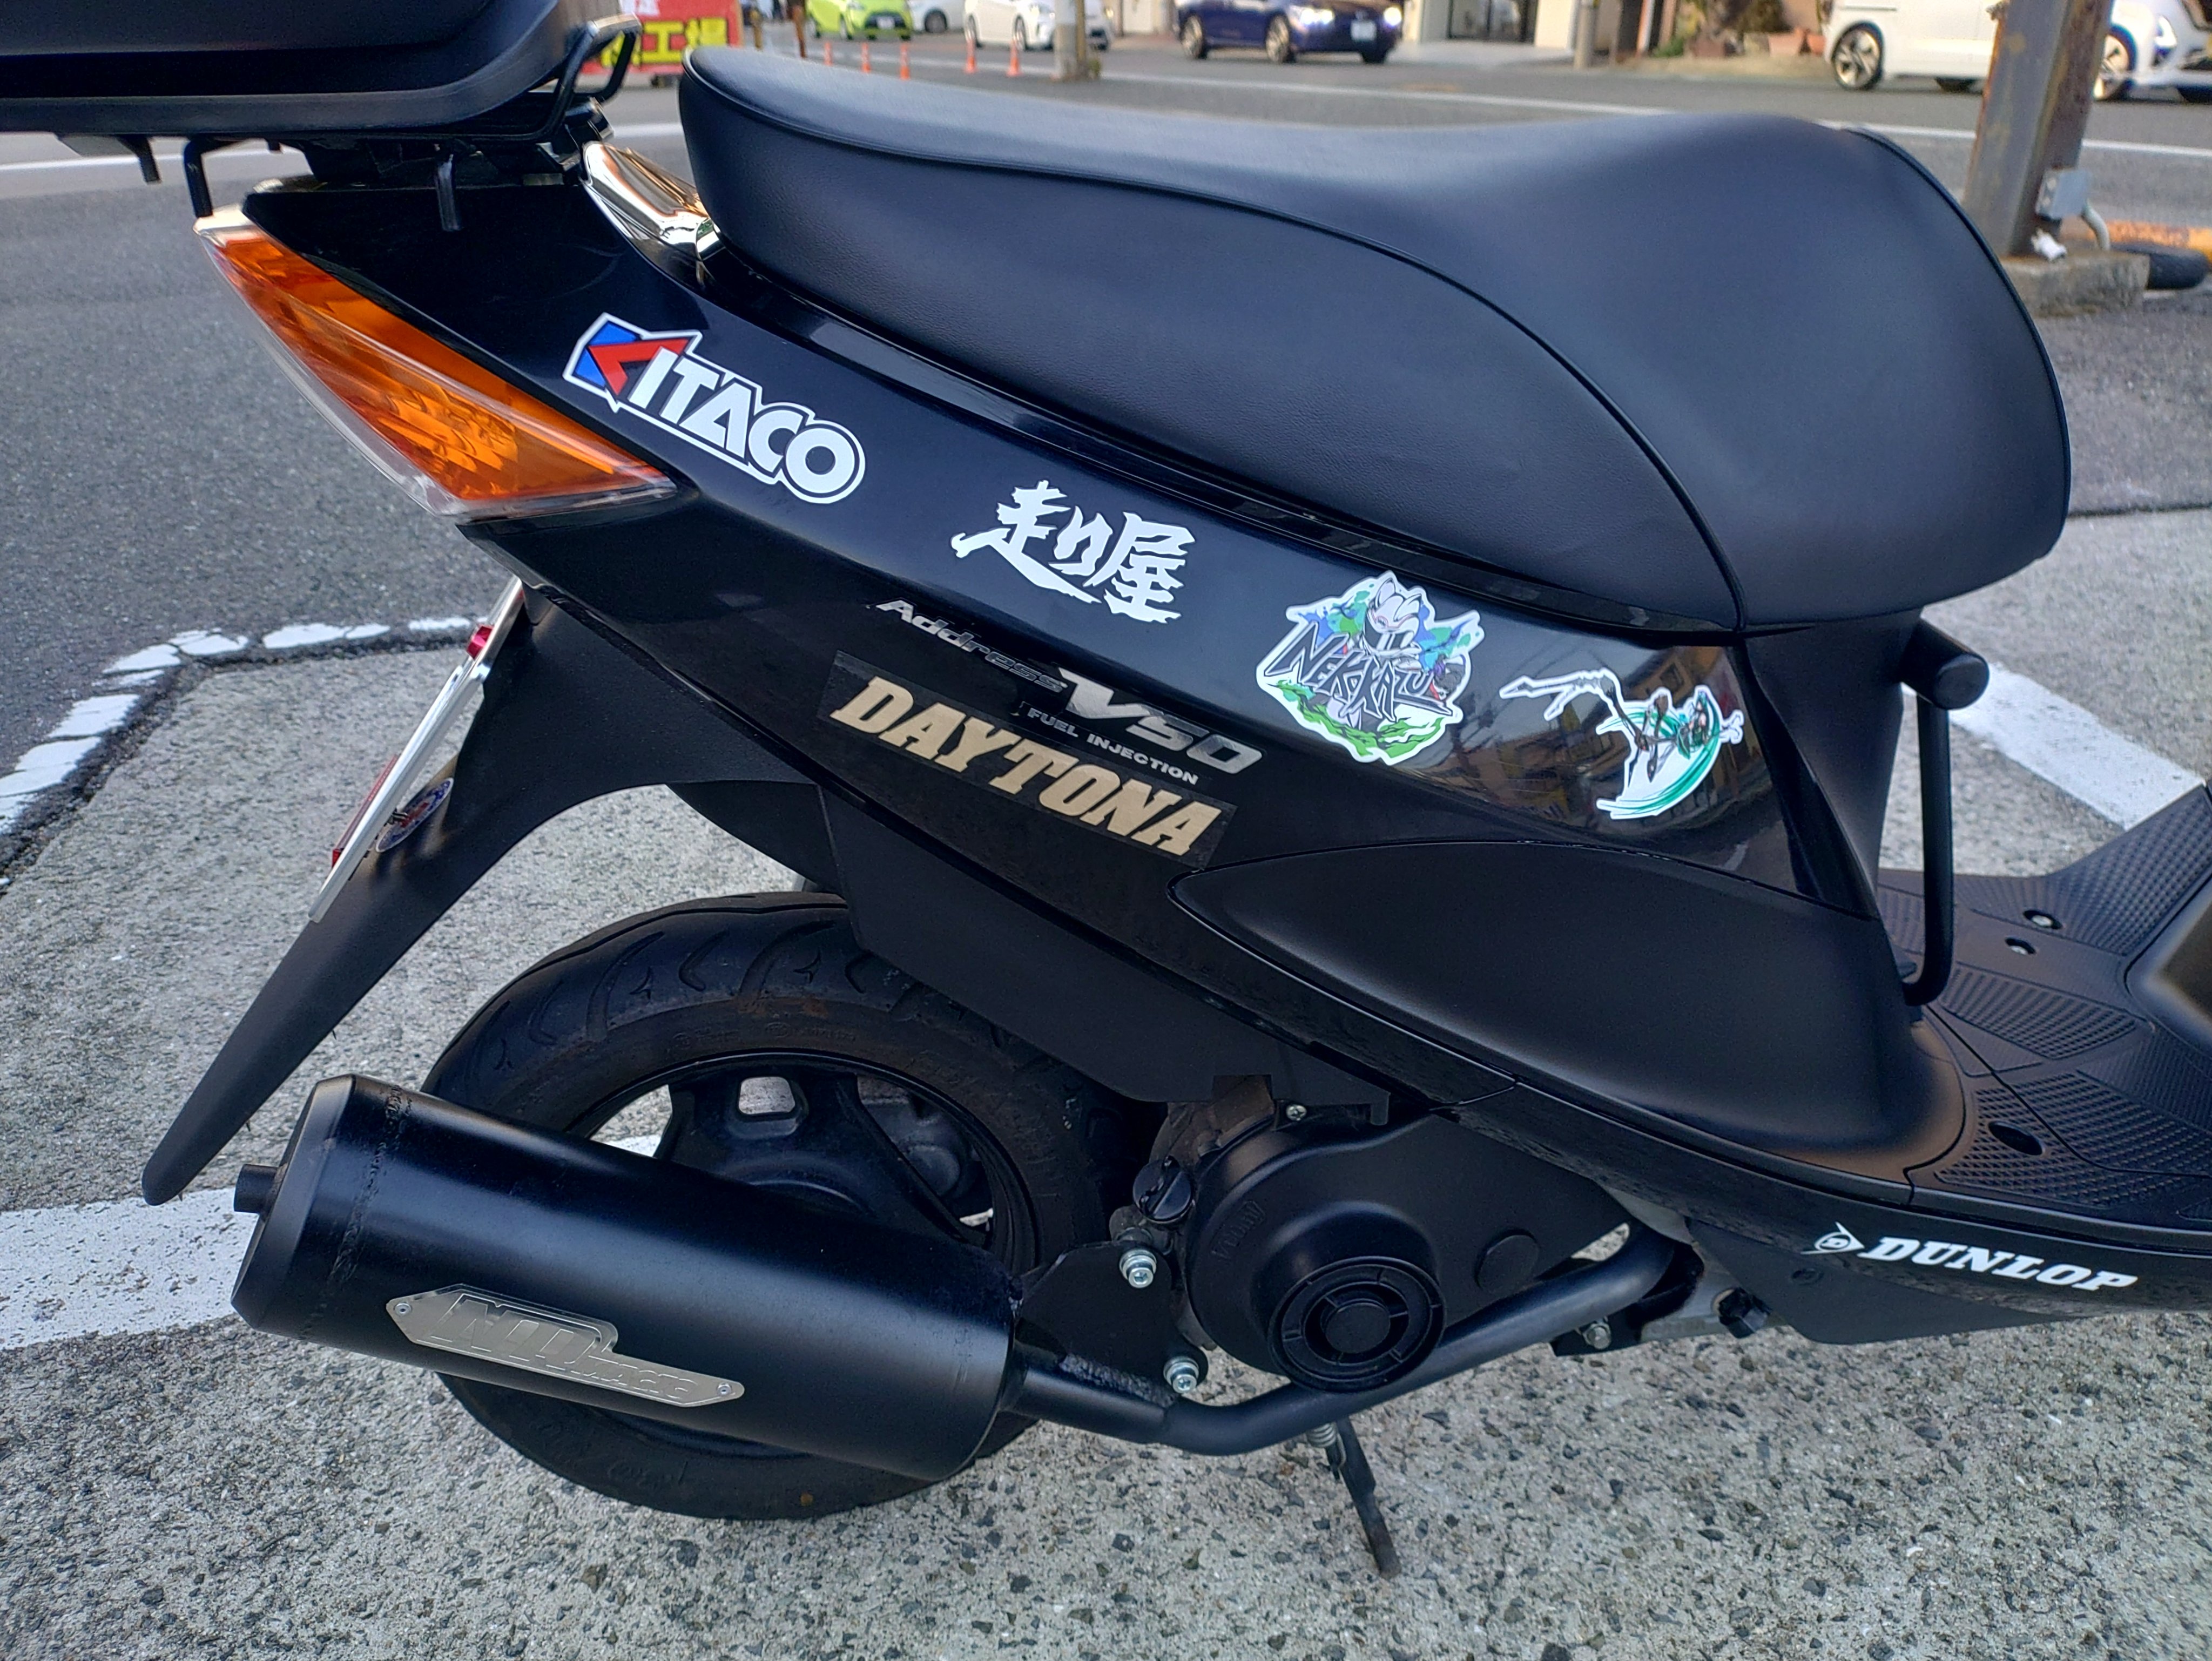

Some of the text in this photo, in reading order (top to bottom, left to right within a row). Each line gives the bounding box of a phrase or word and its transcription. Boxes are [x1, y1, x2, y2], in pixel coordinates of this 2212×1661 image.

[951, 480, 1195, 624] 走り屋
[875, 598, 1068, 693] Address
[830, 676, 1222, 856] DAYTONA
[1028, 708, 1199, 785] FUEL INJECTION
[1857, 1237, 2139, 1291] DUNLOP
